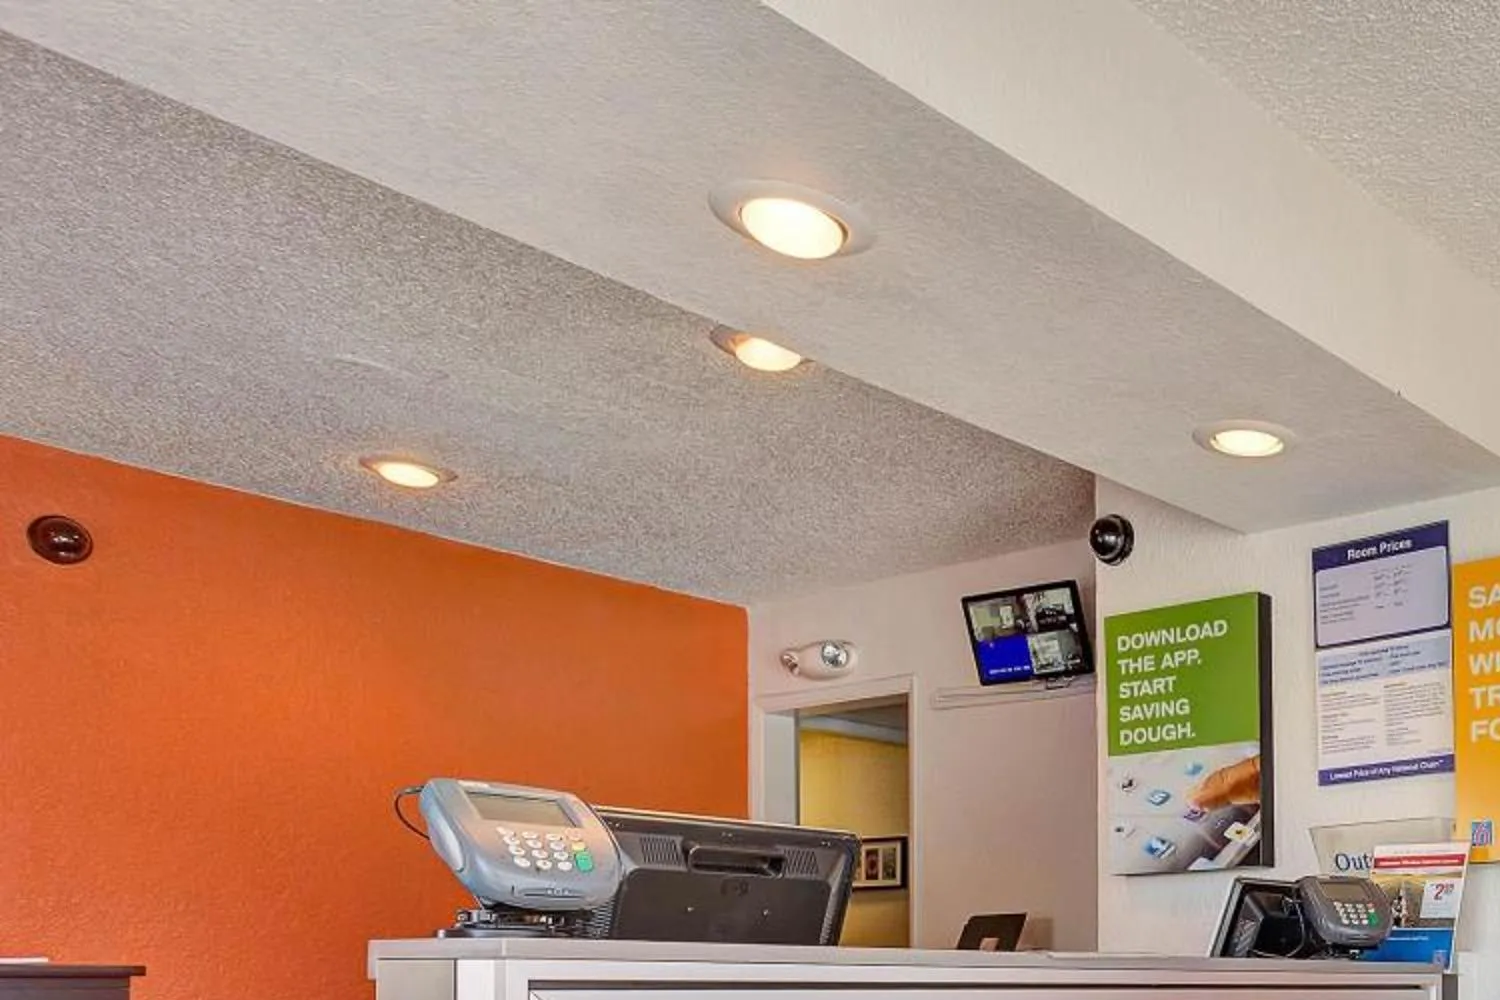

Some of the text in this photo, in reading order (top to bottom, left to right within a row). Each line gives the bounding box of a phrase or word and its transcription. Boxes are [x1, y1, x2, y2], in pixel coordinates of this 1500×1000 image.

[1347, 539, 1412, 561] Room Prices
[1117, 619, 1228, 653] DOWNLOAD
[1117, 649, 1202, 675] THE APP.
[1119, 675, 1176, 699] START
[1119, 698, 1190, 722] SAVING
[1119, 721, 1196, 746] DOUGH.
